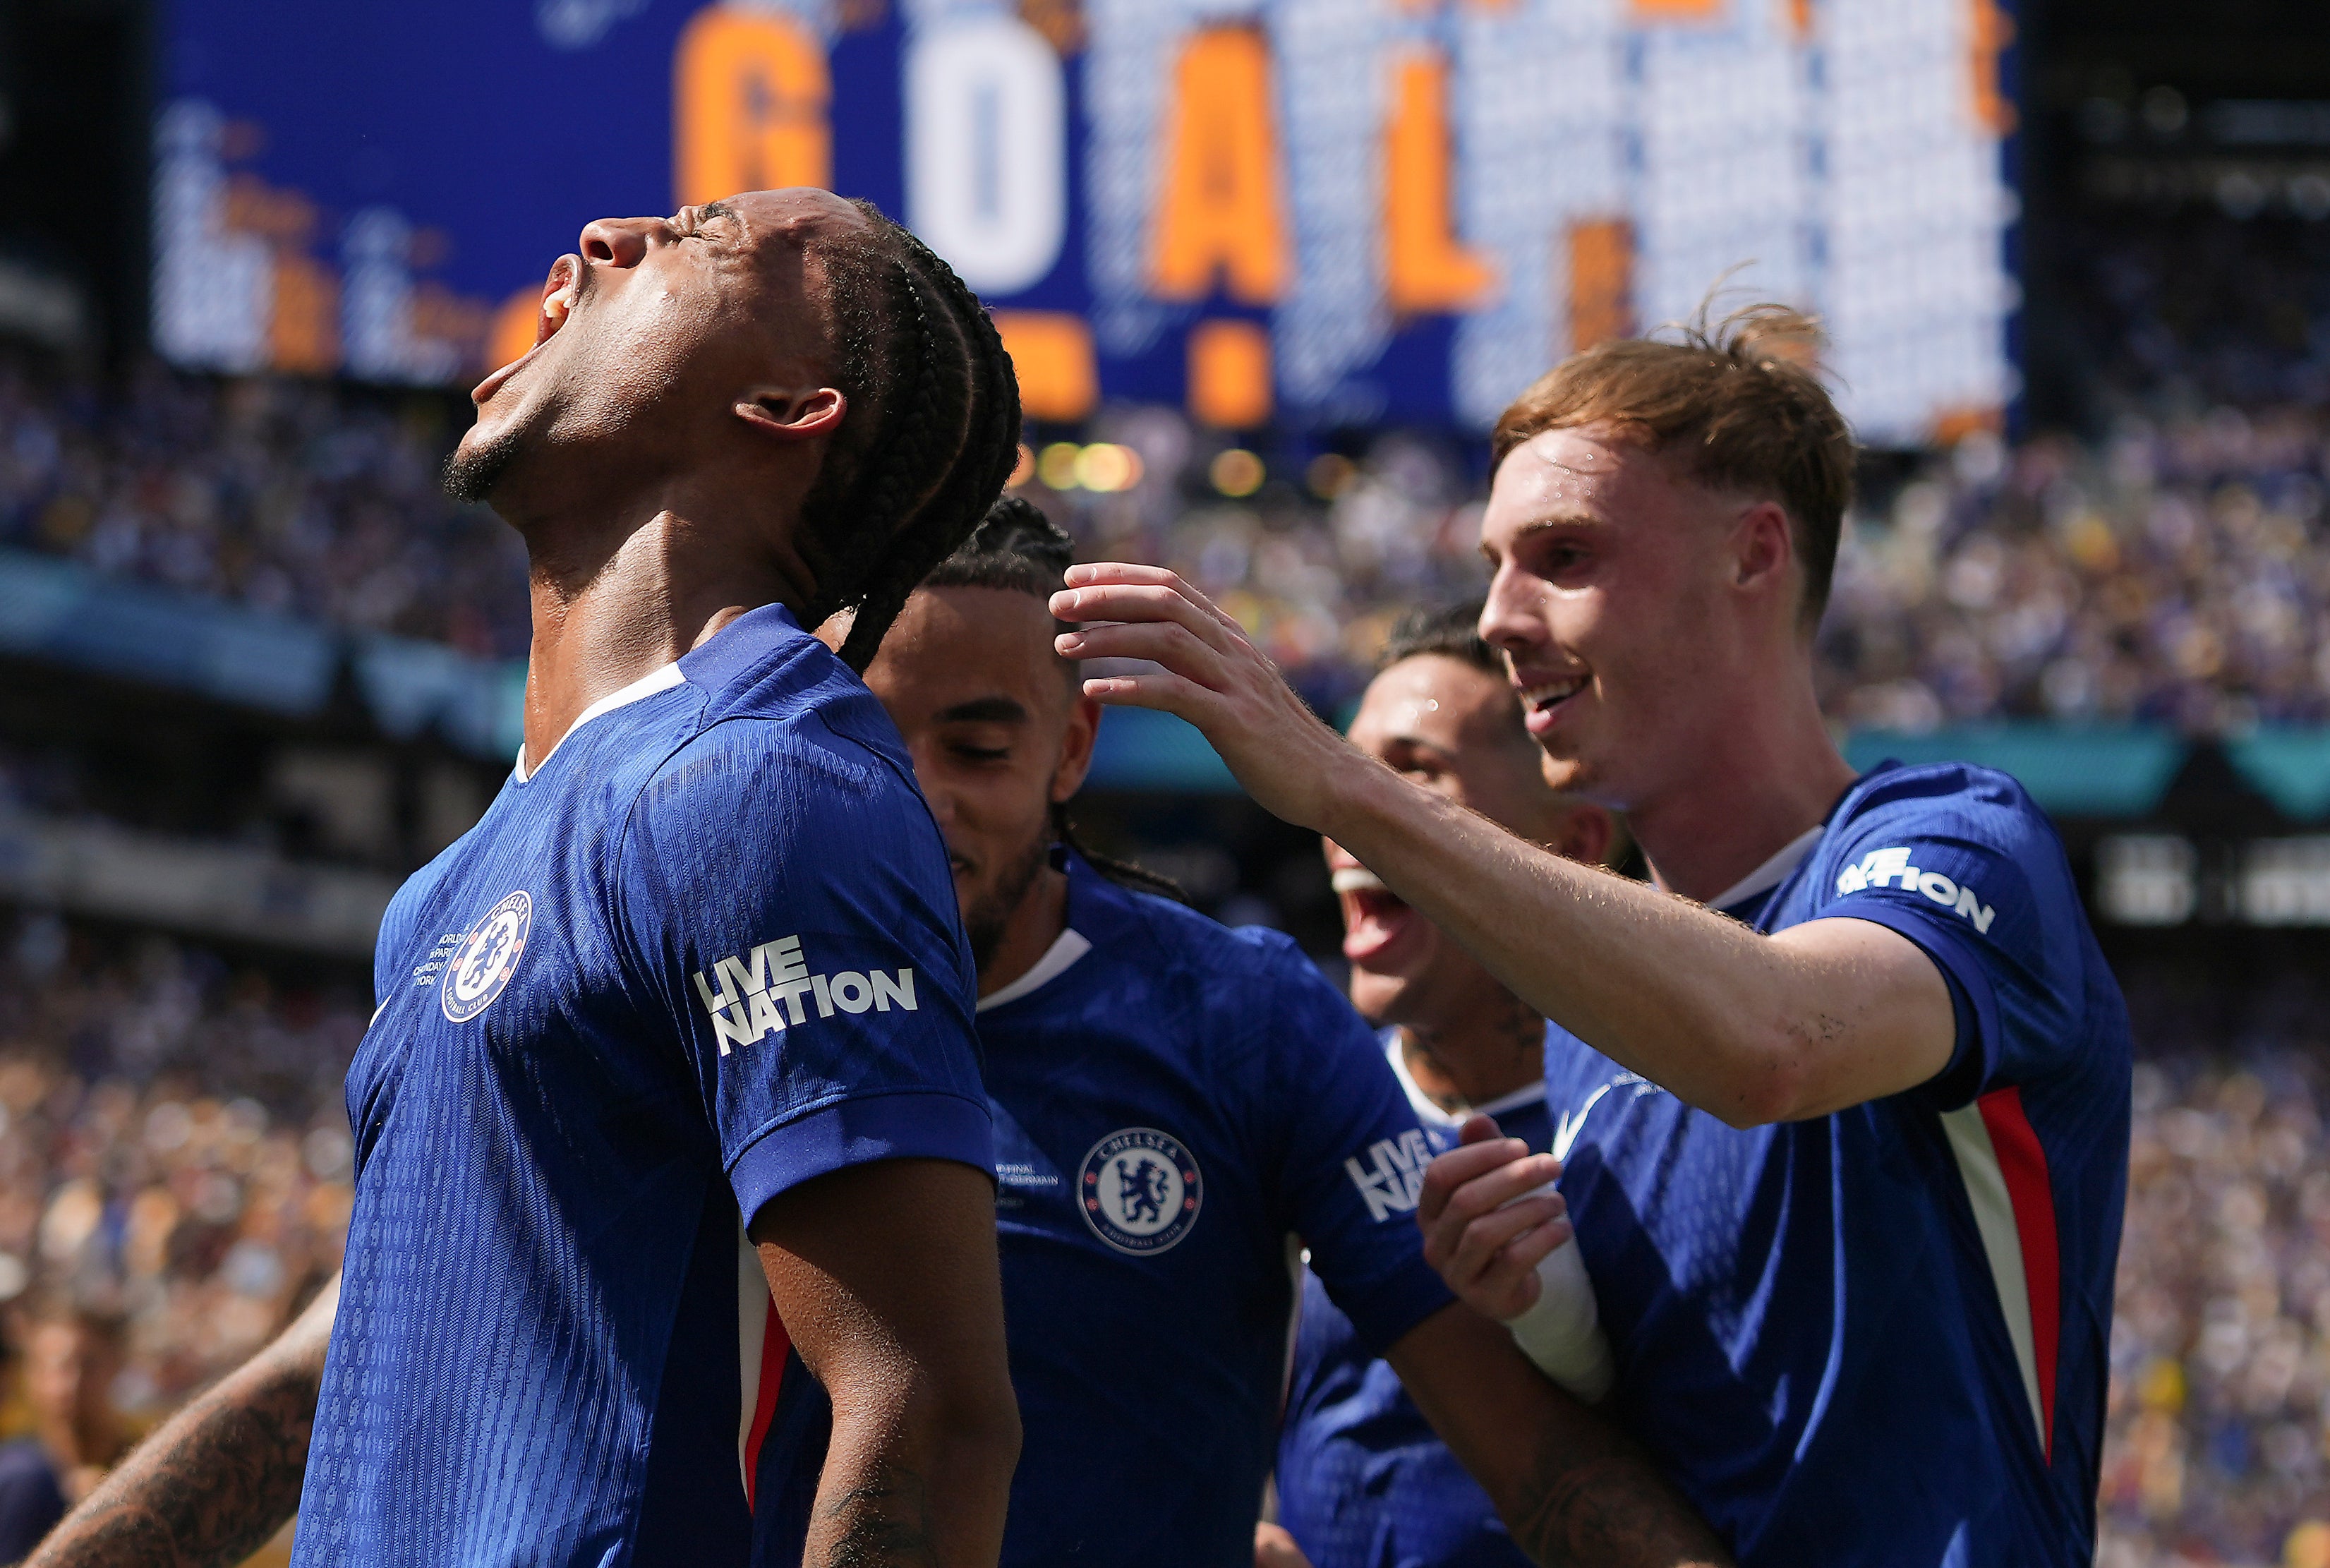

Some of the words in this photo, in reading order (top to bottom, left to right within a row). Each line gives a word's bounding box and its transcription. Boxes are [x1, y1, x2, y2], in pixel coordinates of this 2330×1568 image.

[673, 10, 1499, 312] GOAL
[490, 895, 529, 925] CHELSEA
[447, 986, 466, 1014] FOOTBALL
[467, 993, 488, 1012] CLUB
[693, 934, 810, 1013] LIVE
[710, 968, 918, 1056] NATION
[1098, 1132, 1178, 1159] CHELSEA
[1344, 1128, 1434, 1188] LIVE
[1363, 1168, 1427, 1223] NA
